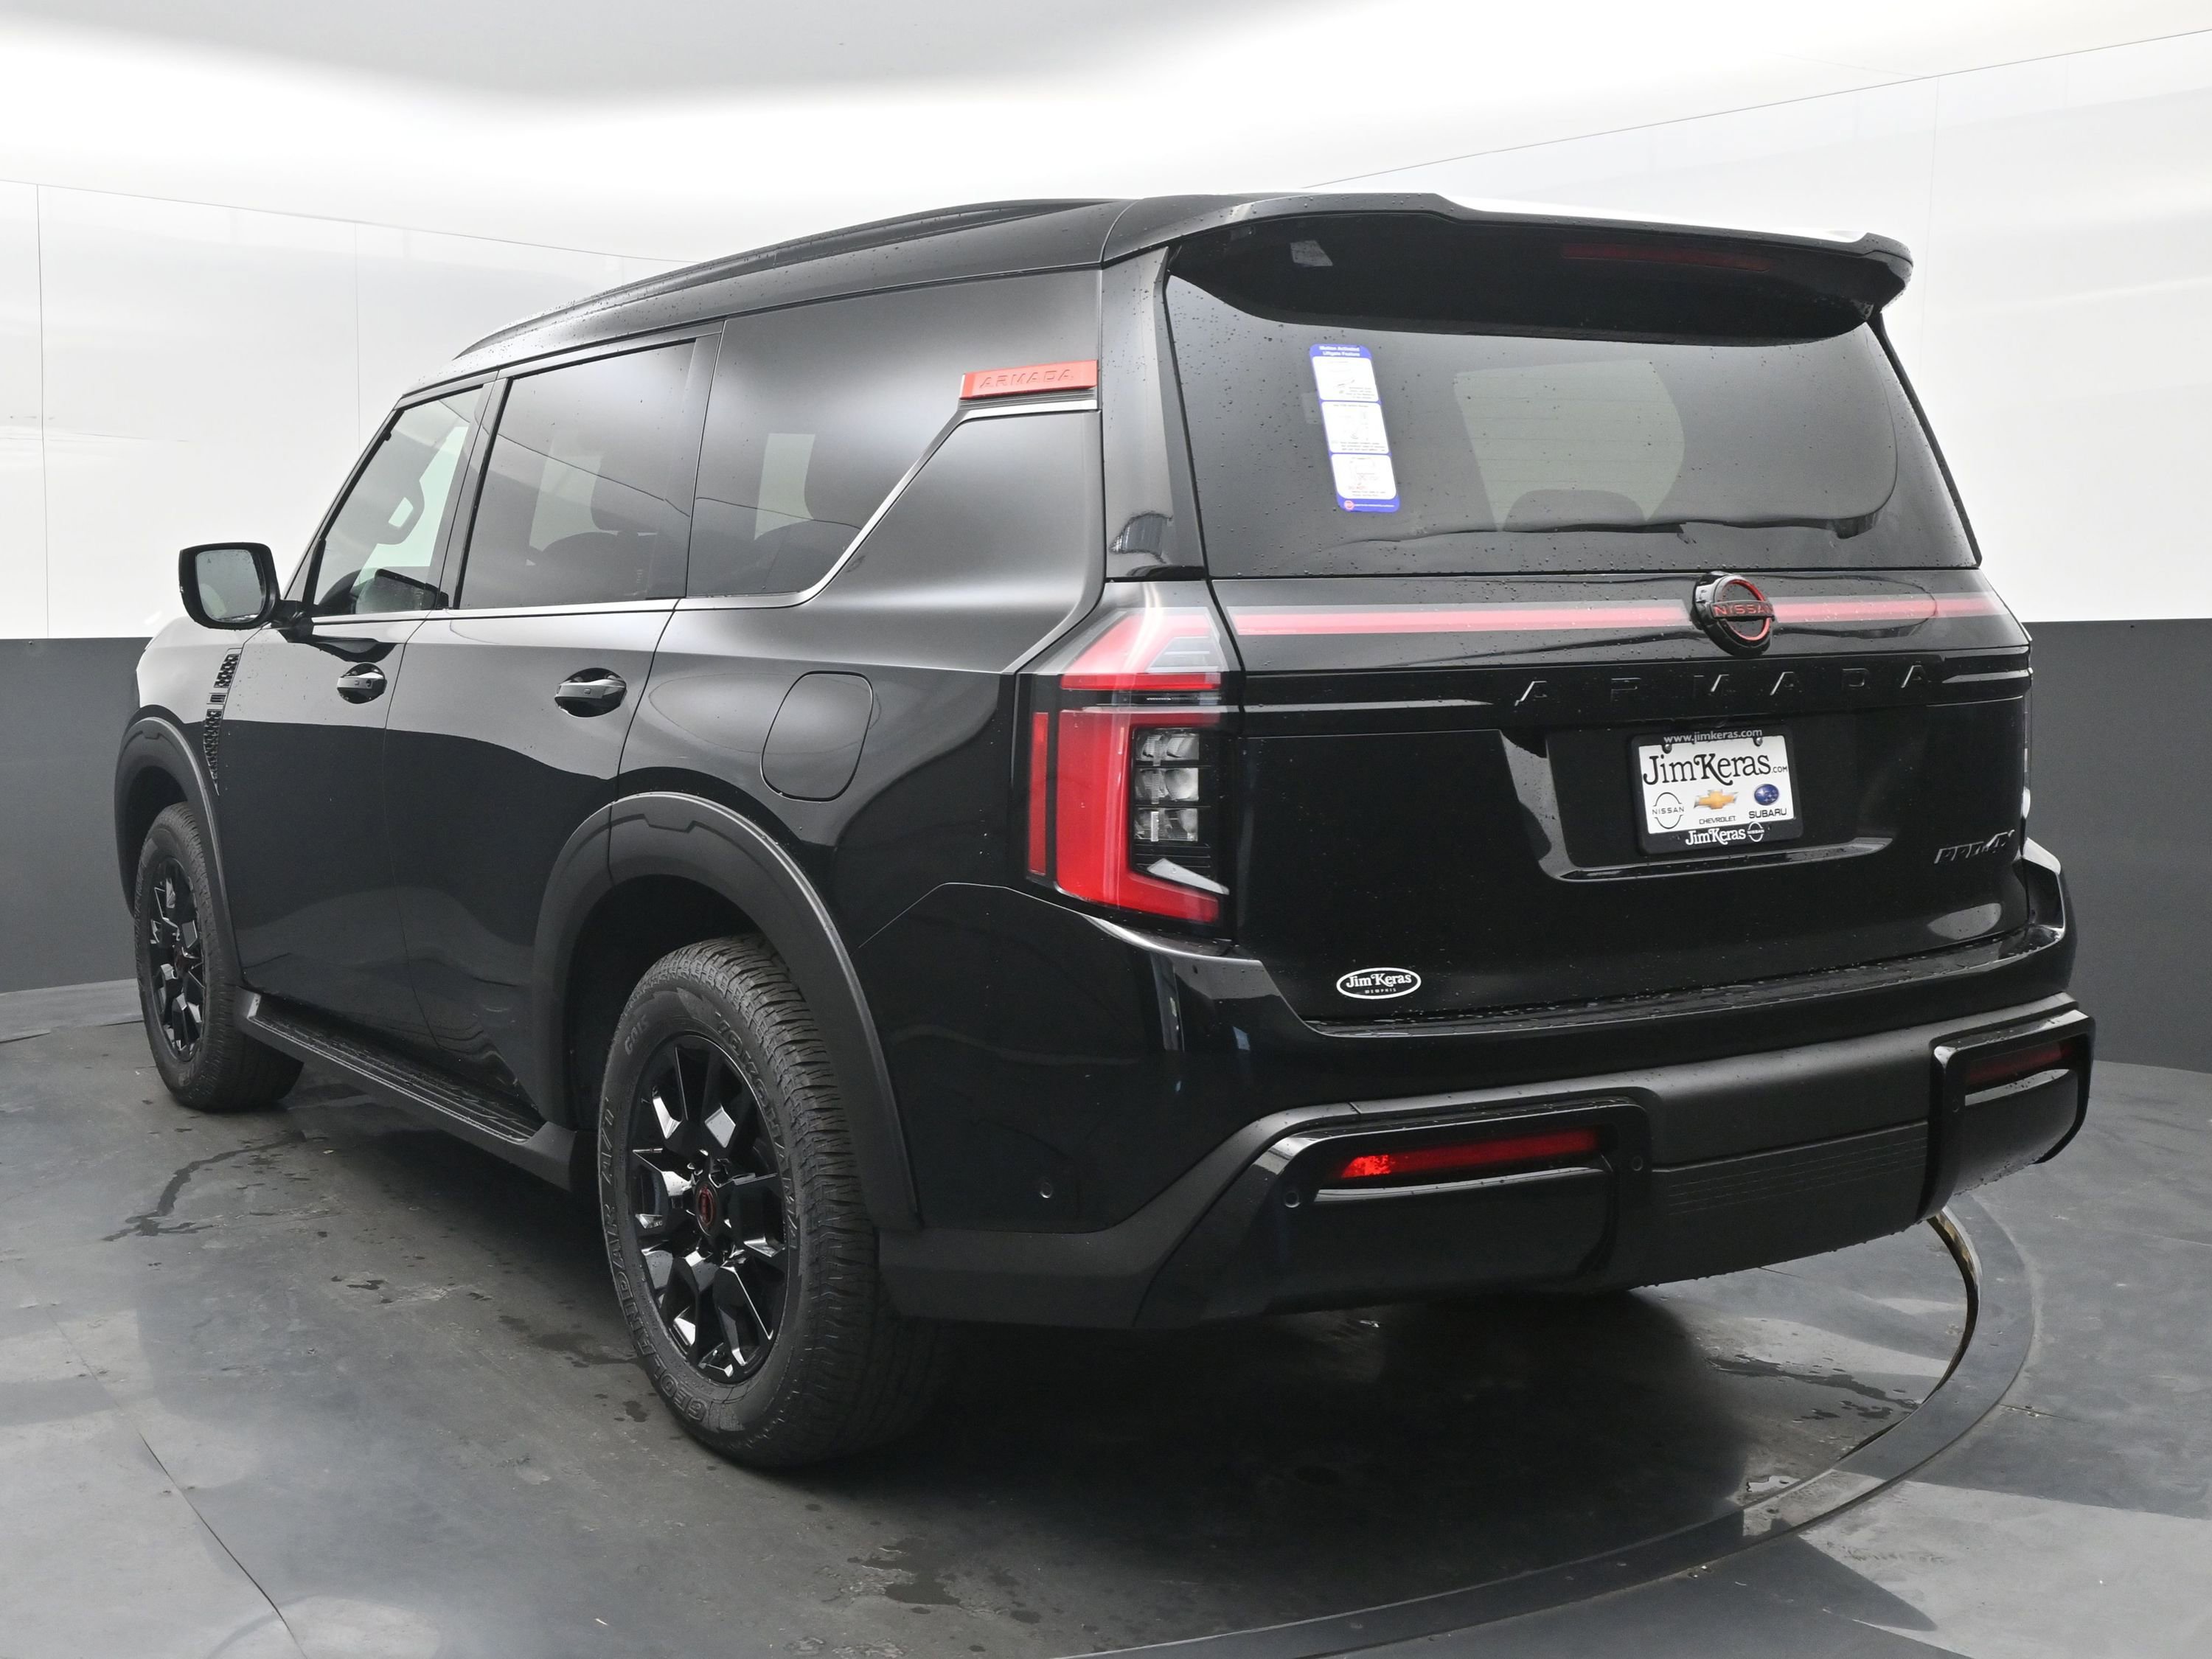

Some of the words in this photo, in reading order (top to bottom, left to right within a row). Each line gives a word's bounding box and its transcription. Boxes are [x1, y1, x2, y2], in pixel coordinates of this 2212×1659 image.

[979, 369, 1074, 389] ARMADA
[1713, 604, 1773, 616] NISSAN
[1663, 728, 1763, 745] www.jimkeras.com
[1652, 806, 1685, 815] NISSAN
[1748, 808, 1787, 819] SUBARU
[1699, 815, 1736, 825] CHEVROLET
